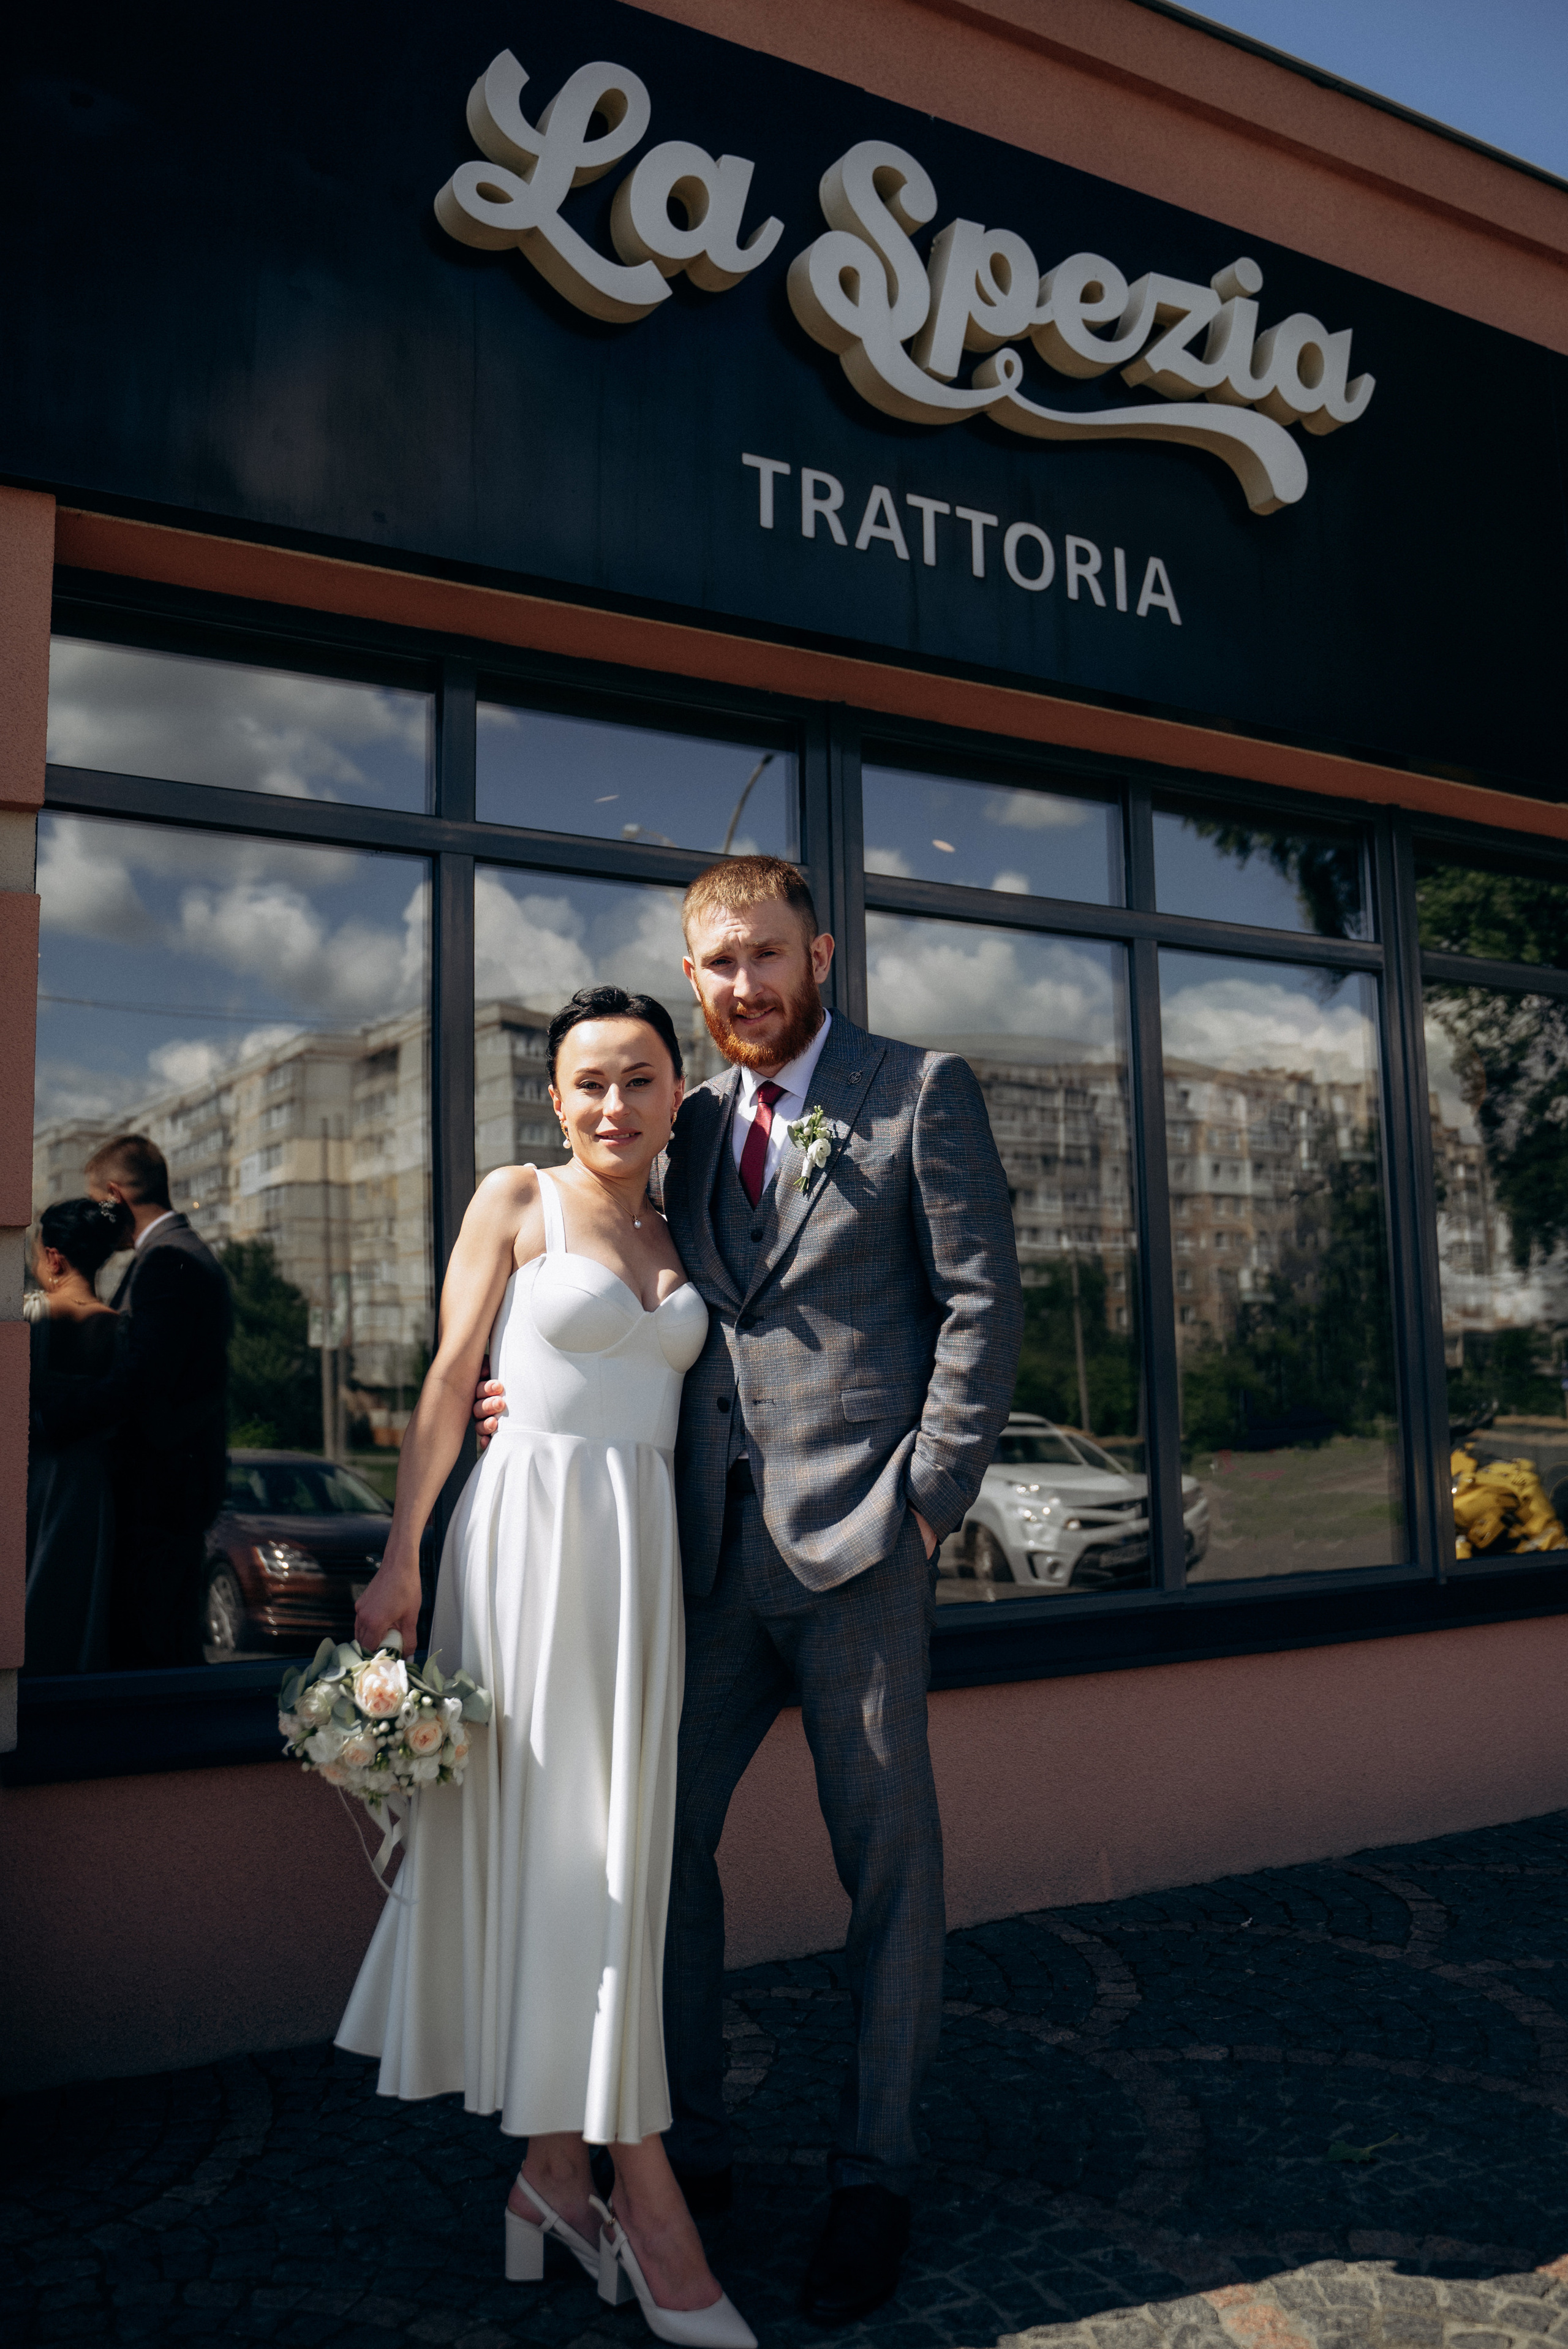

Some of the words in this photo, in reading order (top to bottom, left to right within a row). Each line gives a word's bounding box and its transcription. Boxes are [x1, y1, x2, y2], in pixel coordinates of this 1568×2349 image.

[434, 48, 785, 323] La
[786, 140, 1376, 515] Spezia
[742, 453, 1182, 626] TRATTORIA
